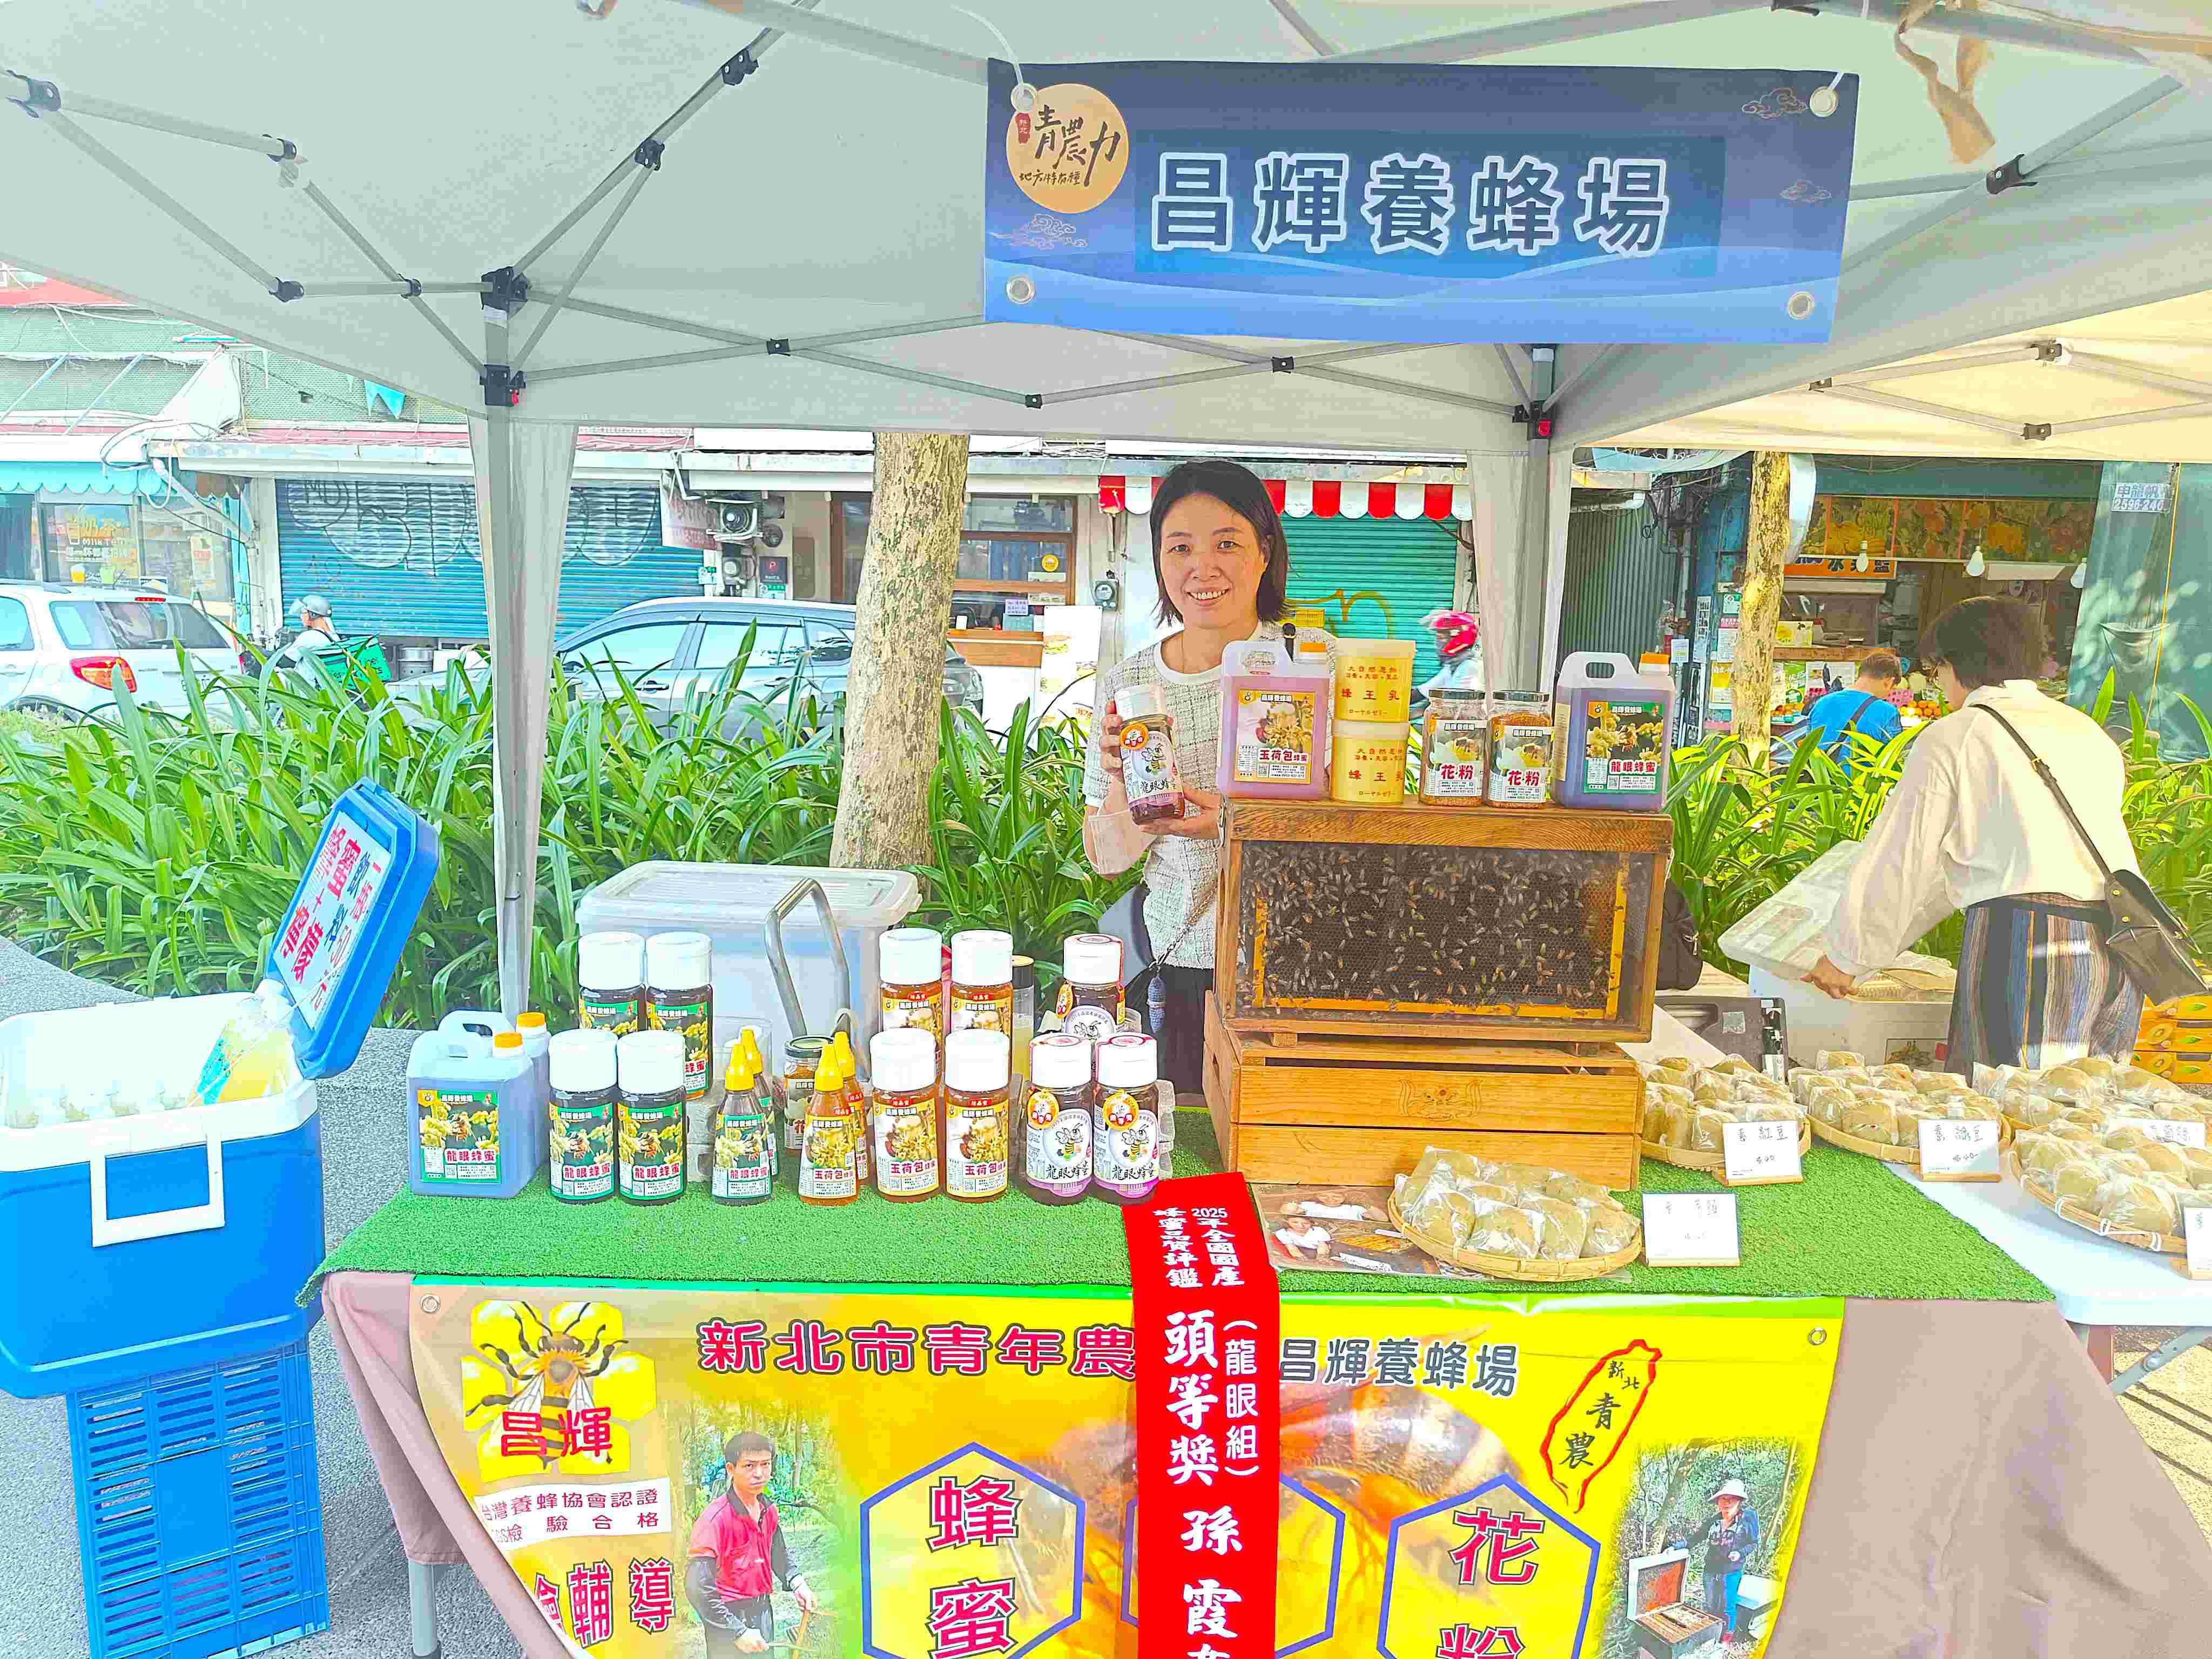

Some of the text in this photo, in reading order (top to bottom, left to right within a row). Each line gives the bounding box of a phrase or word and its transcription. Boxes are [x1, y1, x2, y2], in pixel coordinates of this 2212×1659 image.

[1034, 104, 1121, 187] 青農力
[1019, 168, 1081, 186] 地方特有種
[1152, 151, 1669, 257] 昌輝養蜂場
[1341, 688, 1400, 701] 蜂王乳
[1611, 761, 1655, 773] 龍眼蜂蜜
[447, 1150, 495, 1162] 龍眼蜂蜜
[564, 1162, 610, 1179] 龍眼蜂蜜
[635, 1162, 680, 1179] 龍眼蜂蜜
[730, 1166, 768, 1179] 龍眼蜂蜜
[697, 1316, 1520, 1398] 新北市青年農 昌輝養蜂場
[1607, 1359, 1641, 1390] 新北
[1164, 1309, 1219, 1486] 頭等獎
[501, 1406, 612, 1458] 昌輝
[1559, 1392, 1622, 1469] 青農
[926, 1475, 1024, 1659] 蜂蜜
